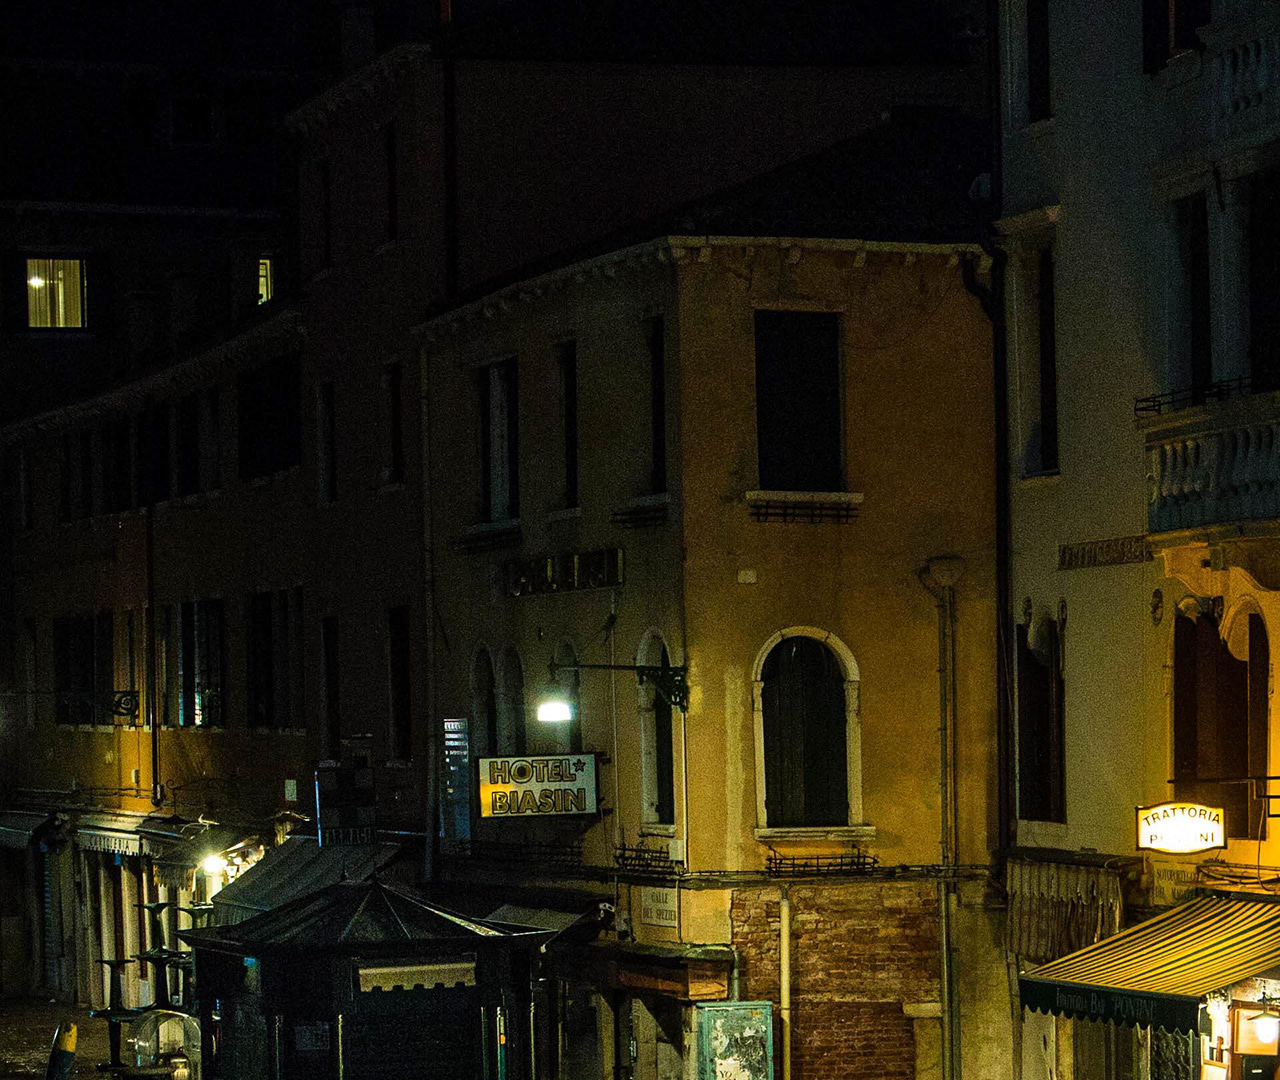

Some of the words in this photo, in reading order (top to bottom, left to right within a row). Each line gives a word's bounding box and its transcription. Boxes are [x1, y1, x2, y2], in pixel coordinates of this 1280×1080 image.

[489, 759, 577, 784] HOTEL
[492, 788, 586, 814] BIASIN
[1143, 806, 1220, 826] TRATTORIA
